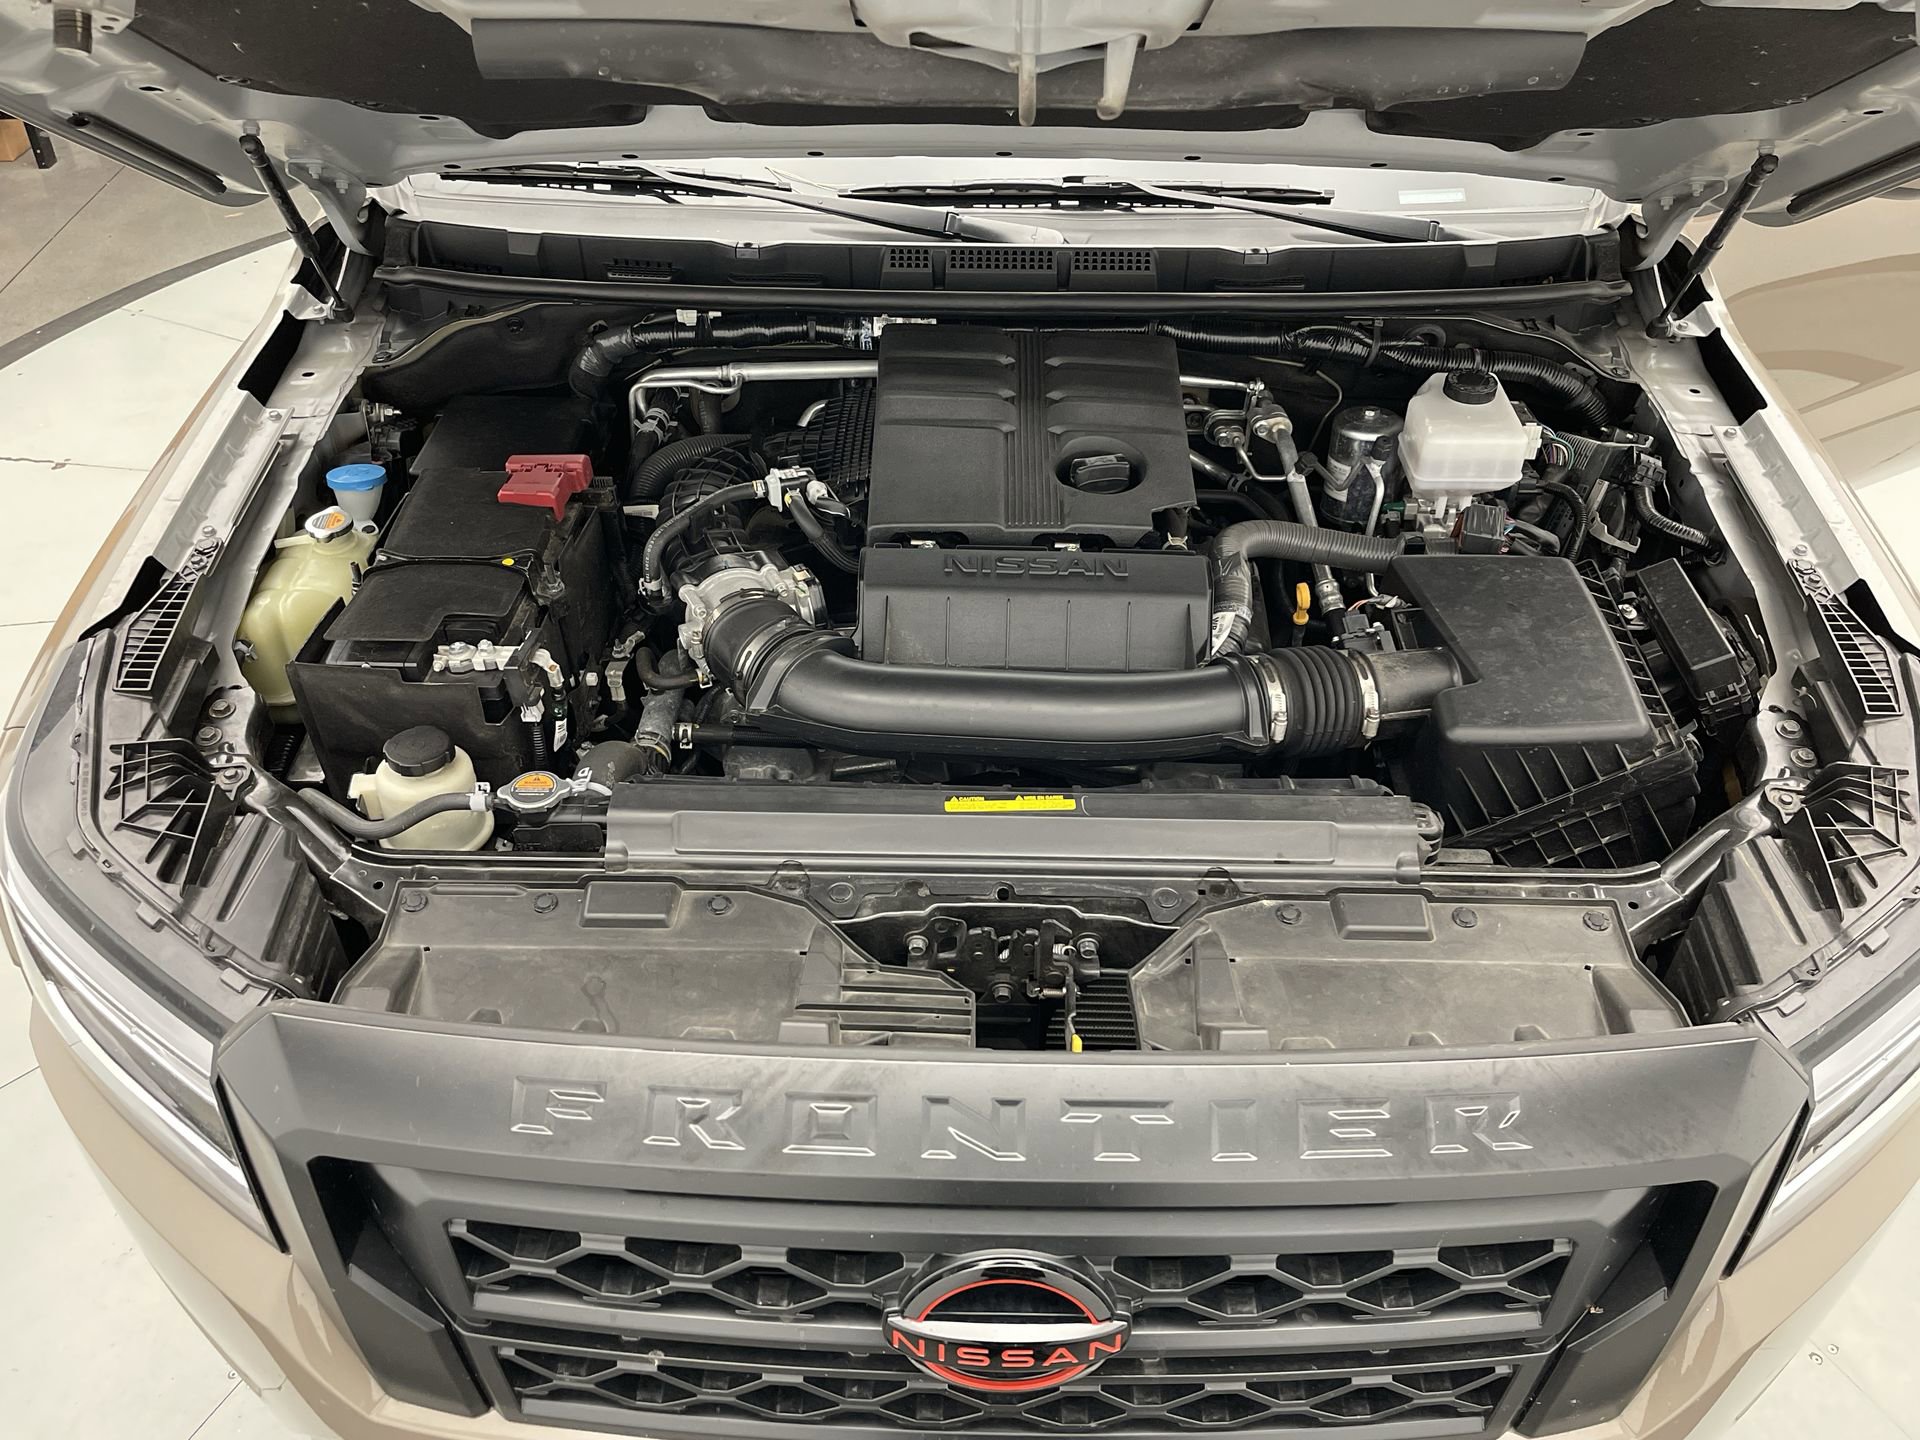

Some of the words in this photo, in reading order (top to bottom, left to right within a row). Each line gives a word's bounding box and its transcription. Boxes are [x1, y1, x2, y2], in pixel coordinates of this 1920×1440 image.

[943, 554, 1129, 577] NISSAN
[509, 1076, 1533, 1163] FRONTIER
[892, 1330, 1122, 1368] NISSAN
